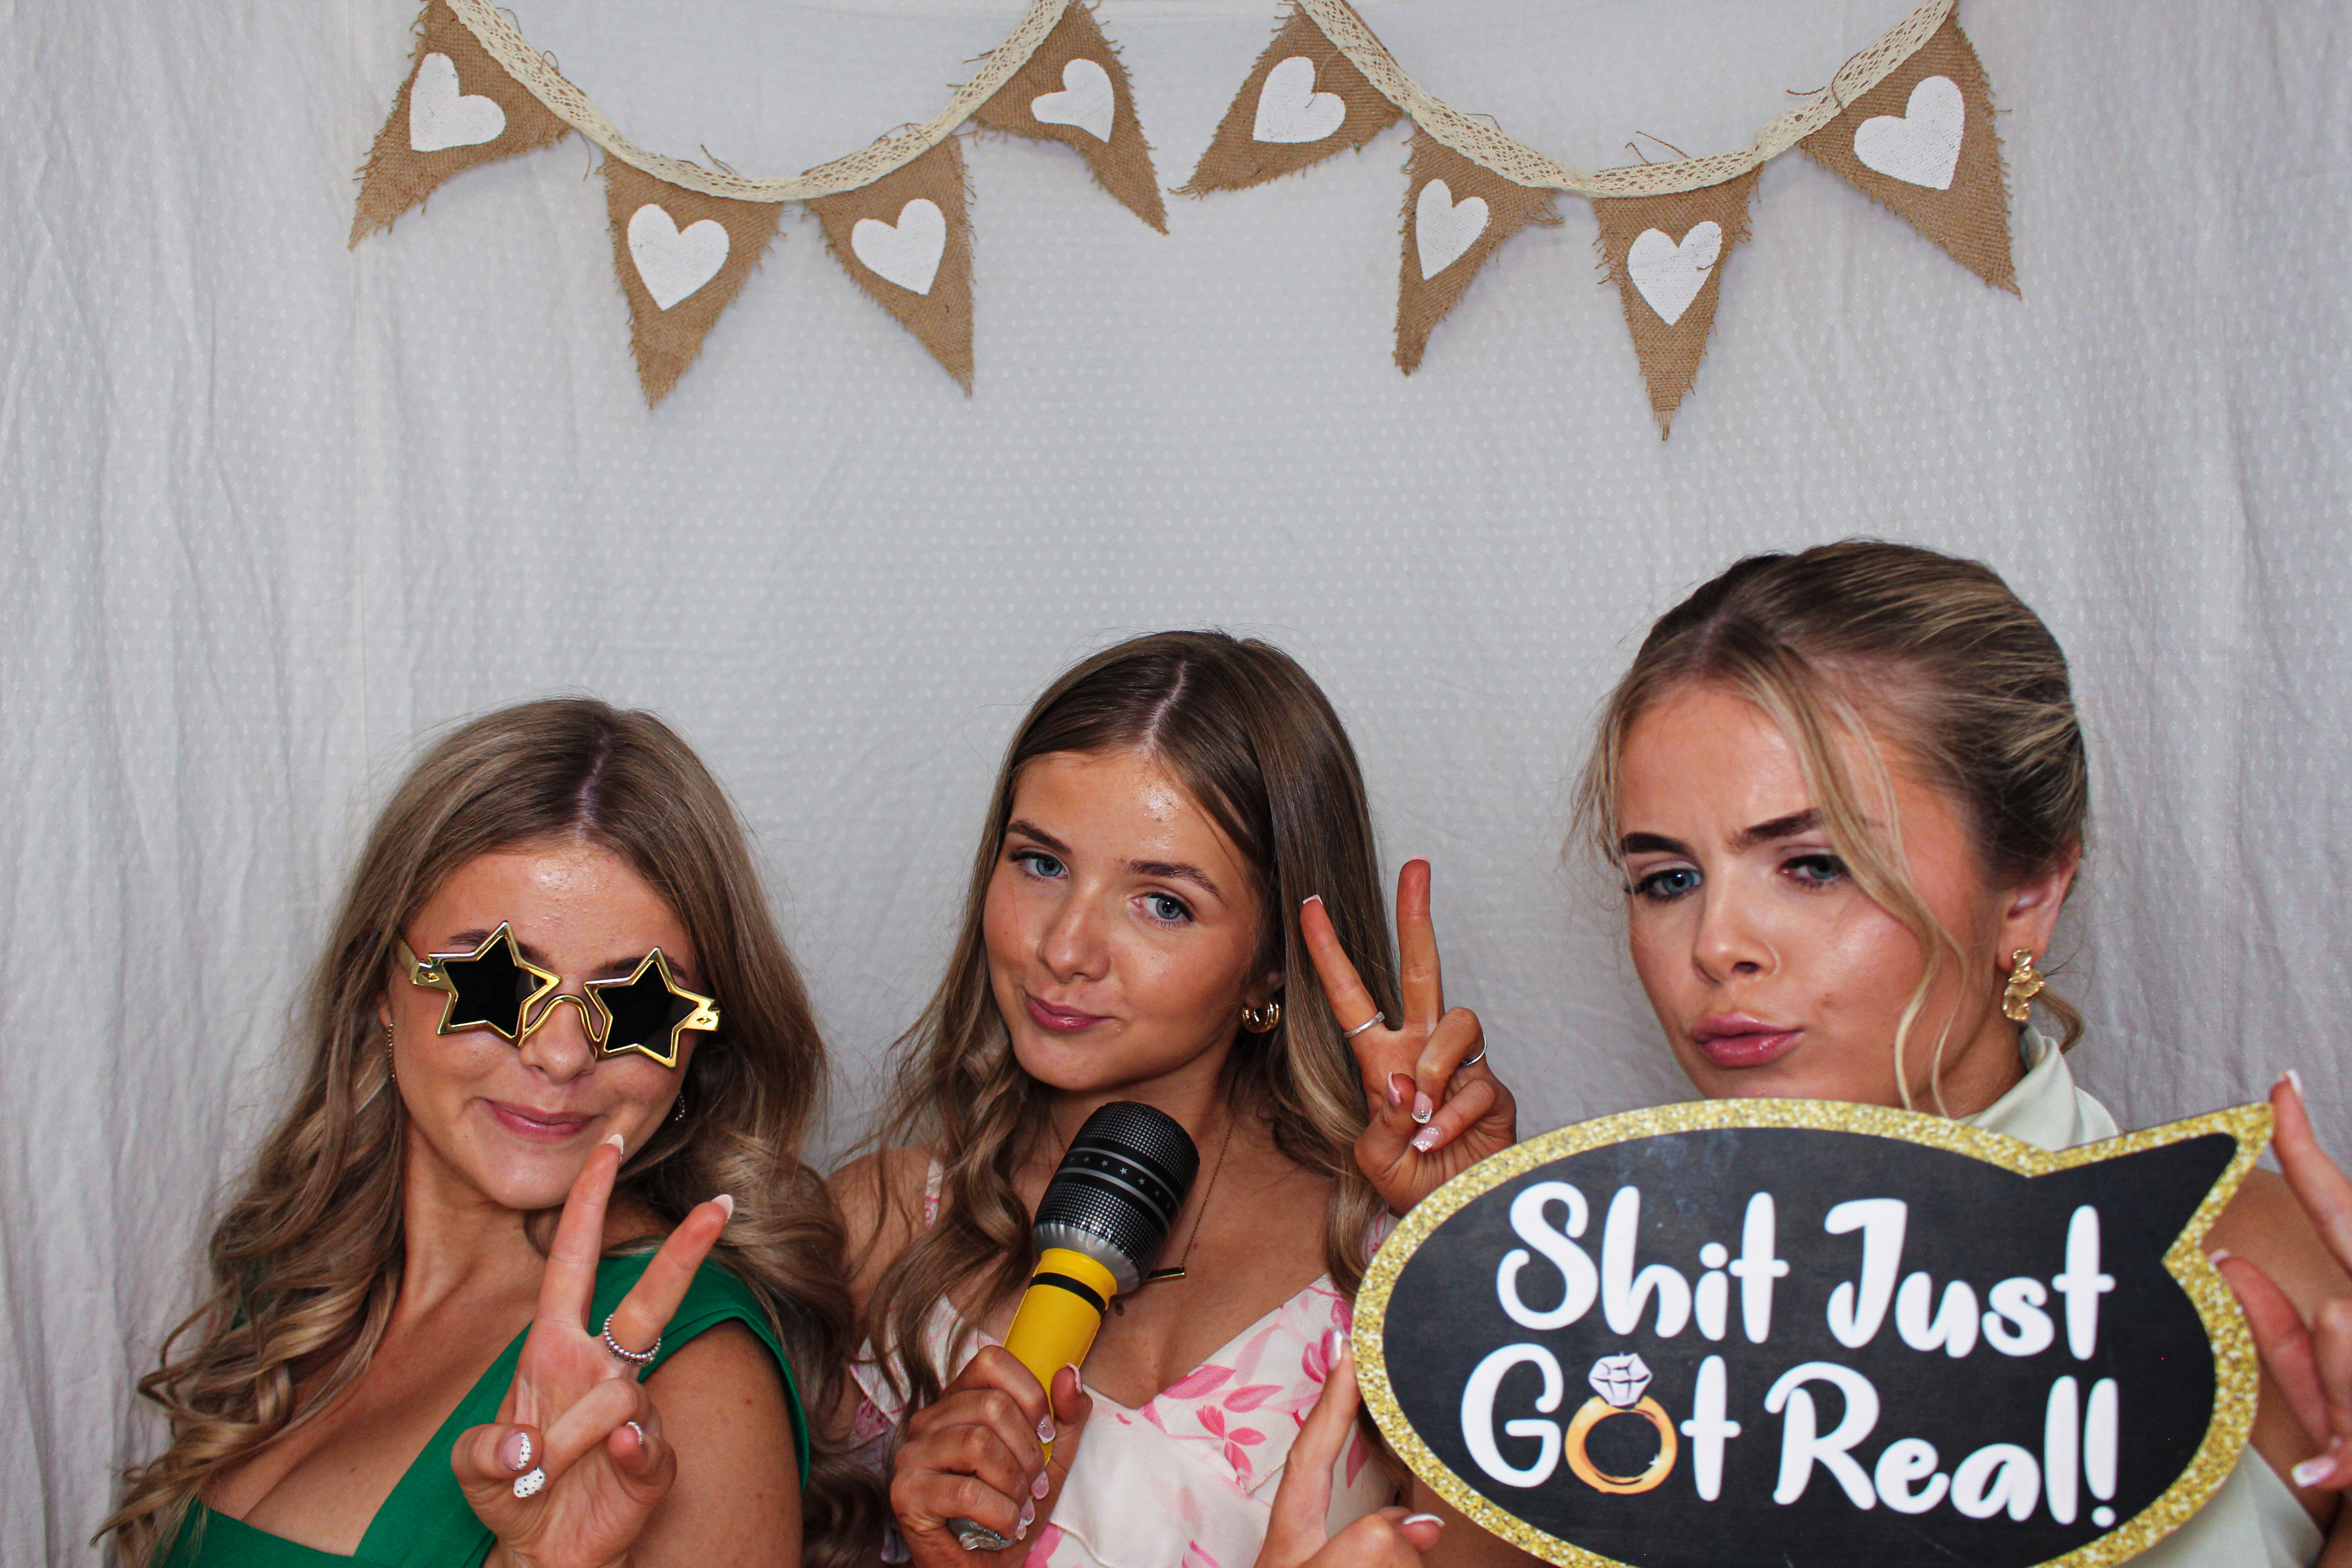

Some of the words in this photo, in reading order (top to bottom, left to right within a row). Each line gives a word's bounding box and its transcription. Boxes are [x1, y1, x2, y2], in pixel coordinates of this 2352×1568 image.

[1497, 1181, 1790, 1344] Shit
[1825, 1198, 2115, 1360] Just
[1461, 1343, 1741, 1501] Got
[1764, 1362, 2118, 1528] Real!
